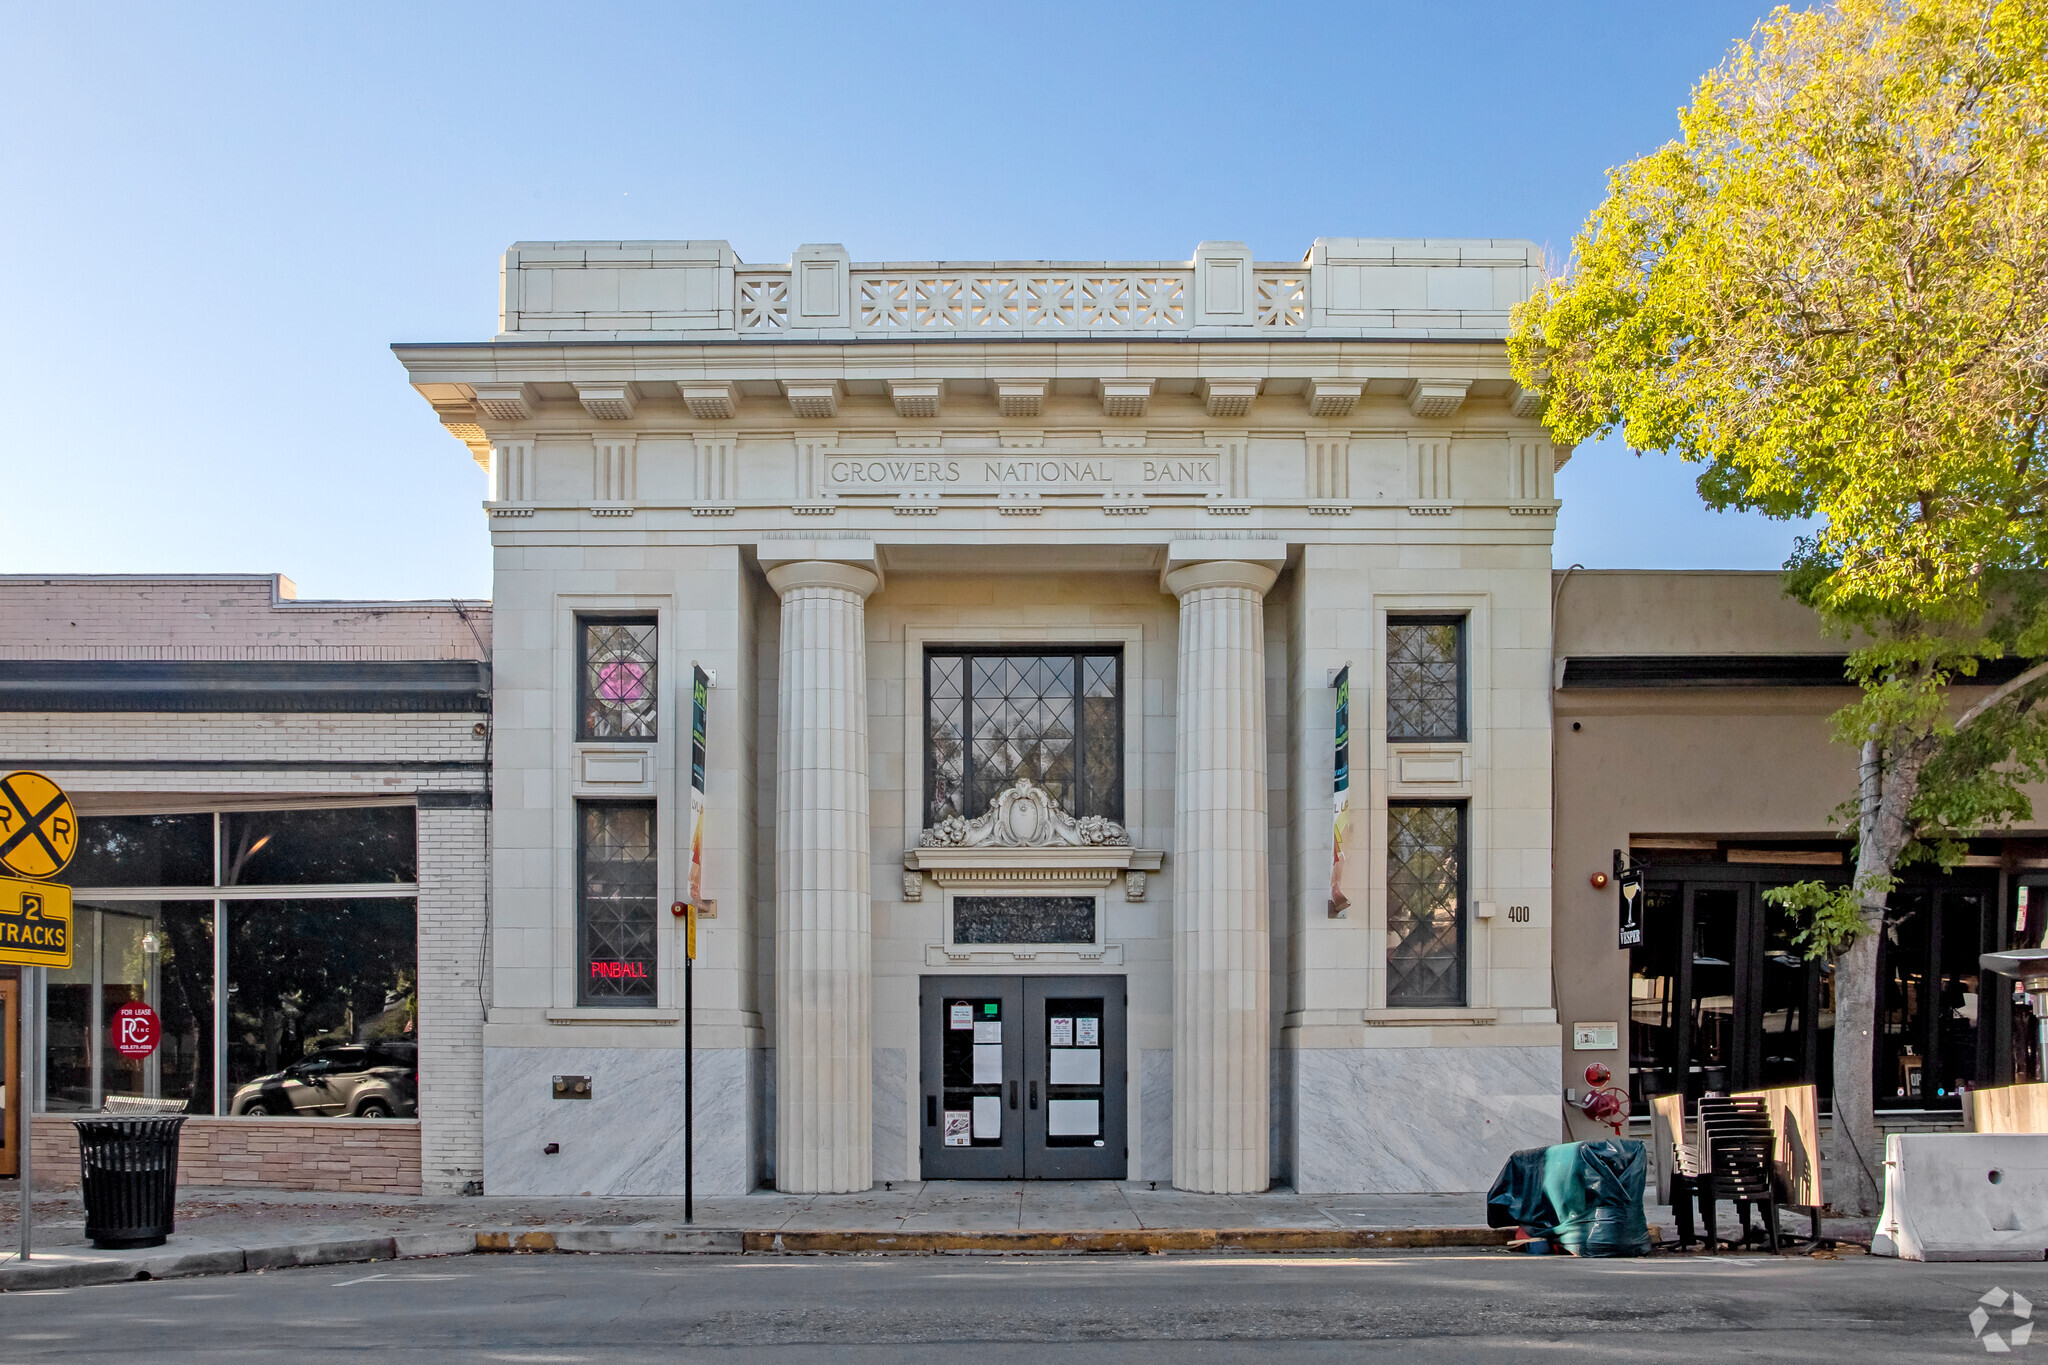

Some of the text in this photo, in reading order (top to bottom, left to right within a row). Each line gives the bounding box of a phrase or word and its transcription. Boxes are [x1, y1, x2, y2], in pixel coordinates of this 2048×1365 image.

[831, 461, 1213, 482] GROWERS NATIONAL BANK
[52, 816, 71, 845] R
[25, 898, 39, 921] 2
[1508, 906, 1530, 922] 400
[1620, 930, 1640, 944] VESPER
[591, 961, 648, 978] PINBALL
[134, 1008, 152, 1016] LEASE
